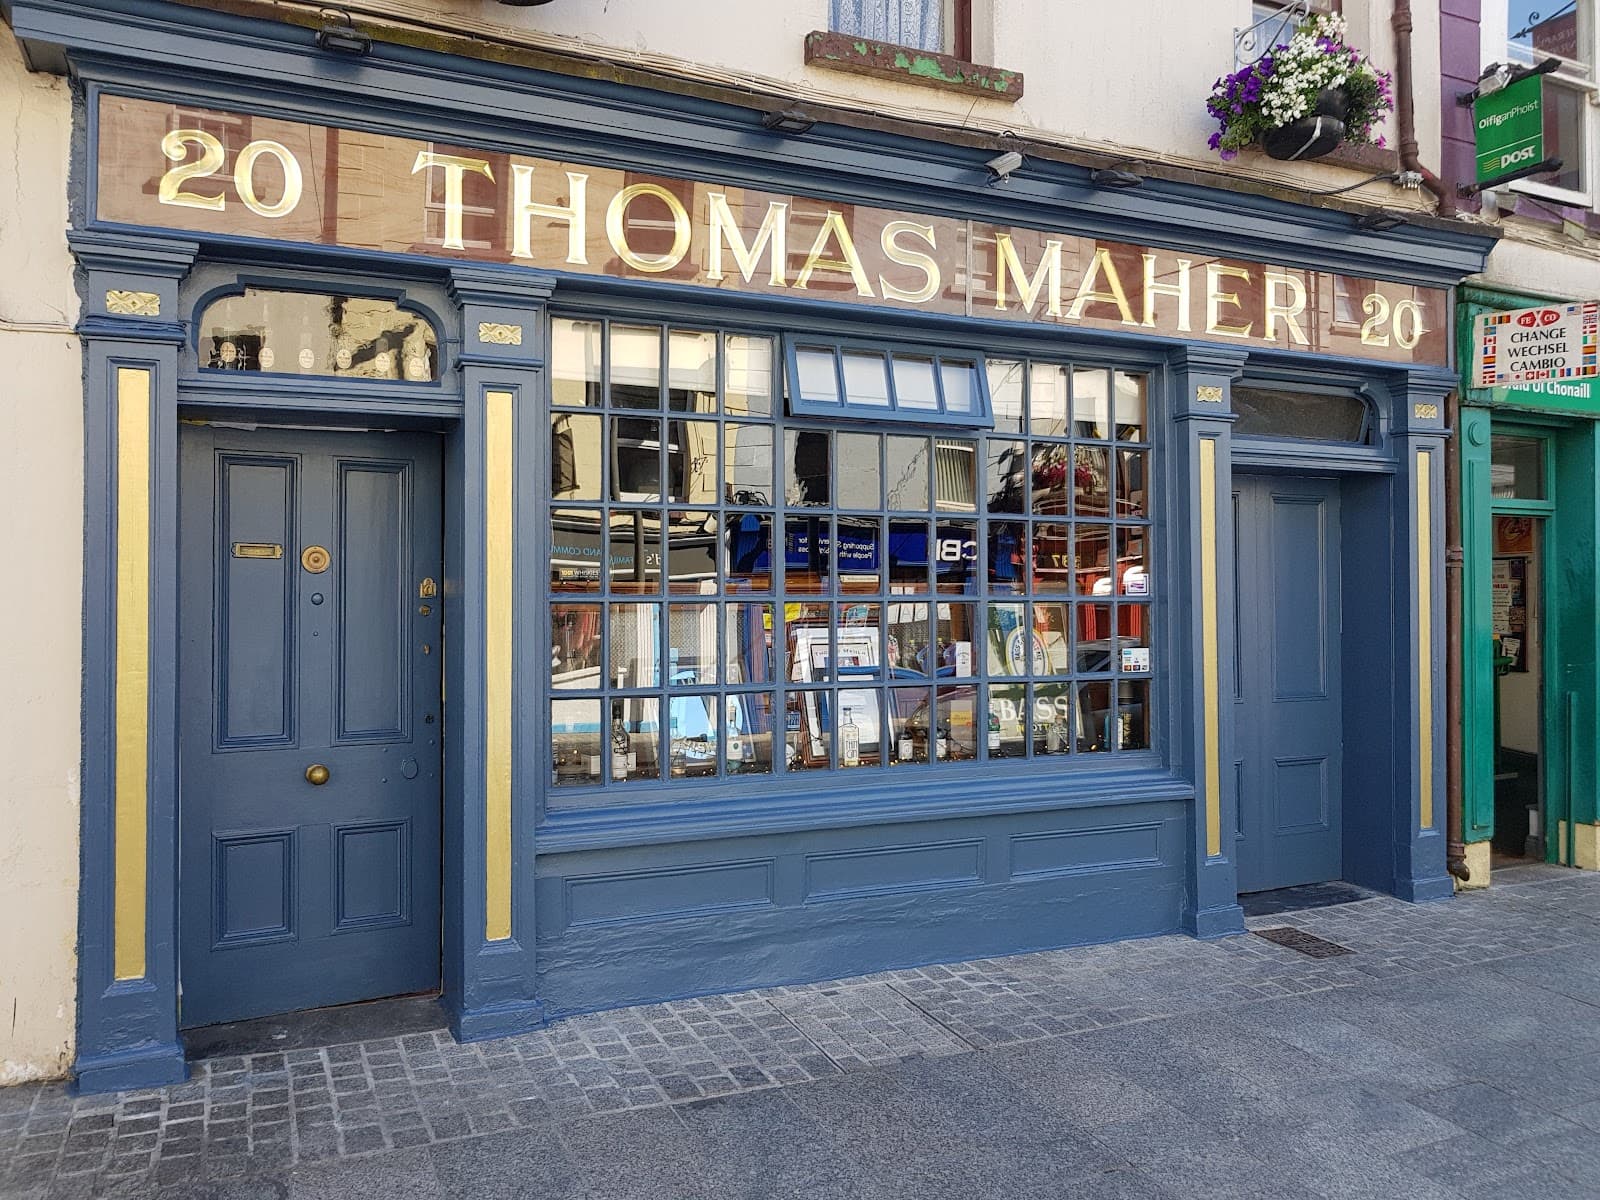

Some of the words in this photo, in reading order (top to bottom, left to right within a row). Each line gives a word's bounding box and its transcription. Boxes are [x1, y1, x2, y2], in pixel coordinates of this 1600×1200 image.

[158, 129, 303, 218] 20
[411, 150, 942, 303] THOMAS
[994, 232, 1311, 346] MAHER
[1361, 293, 1426, 351] 20
[1510, 327, 1567, 343] CHANGE
[1508, 342, 1569, 358] WECHSEL
[1510, 357, 1566, 372] CAMBIO
[1546, 381, 1591, 398] Chonaill
